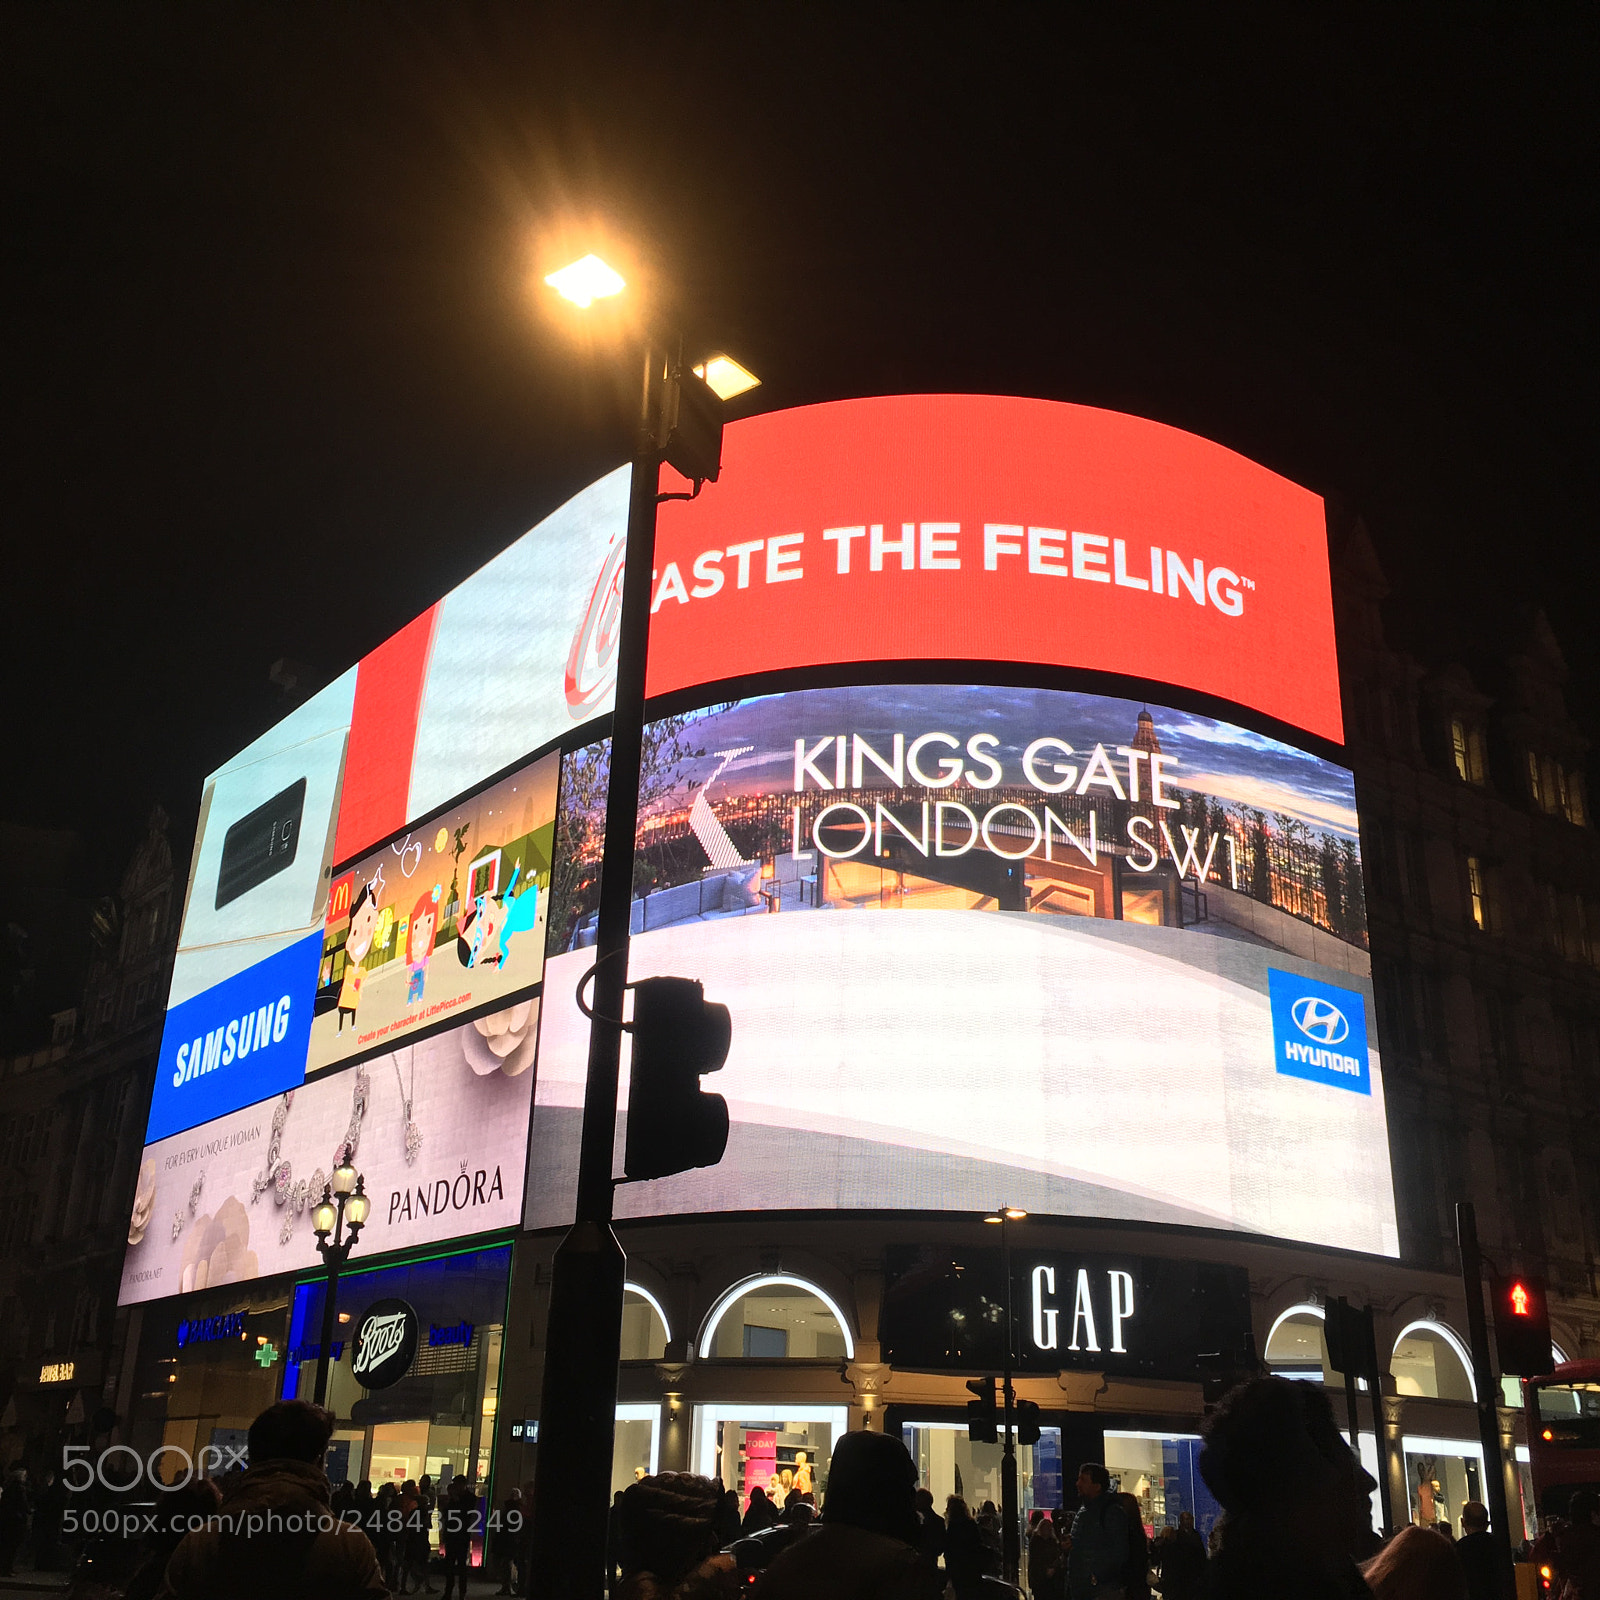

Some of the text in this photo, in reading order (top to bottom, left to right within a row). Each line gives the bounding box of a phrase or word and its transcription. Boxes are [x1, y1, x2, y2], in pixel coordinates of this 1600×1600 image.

[650, 532, 804, 614] ASTE
[823, 522, 962, 575] THE
[794, 732, 1182, 810] KINGS GATE
[792, 801, 1238, 890] LONDON SW1
[173, 995, 291, 1088] SAMSUNG
[358, 992, 472, 1045] Create your character at LittlePicca.com
[1285, 1040, 1361, 1077] HYUNDAI
[165, 1125, 262, 1170] FOR EVERY UNIQUE WOMAN
[388, 1164, 504, 1225] PANDORA
[189, 1312, 246, 1344] BARCLAYS
[429, 1320, 474, 1347] beauty
[1032, 1265, 1135, 1353] GAP
[353, 1312, 407, 1374] Boots
[747, 1440, 775, 1449] TODAY
